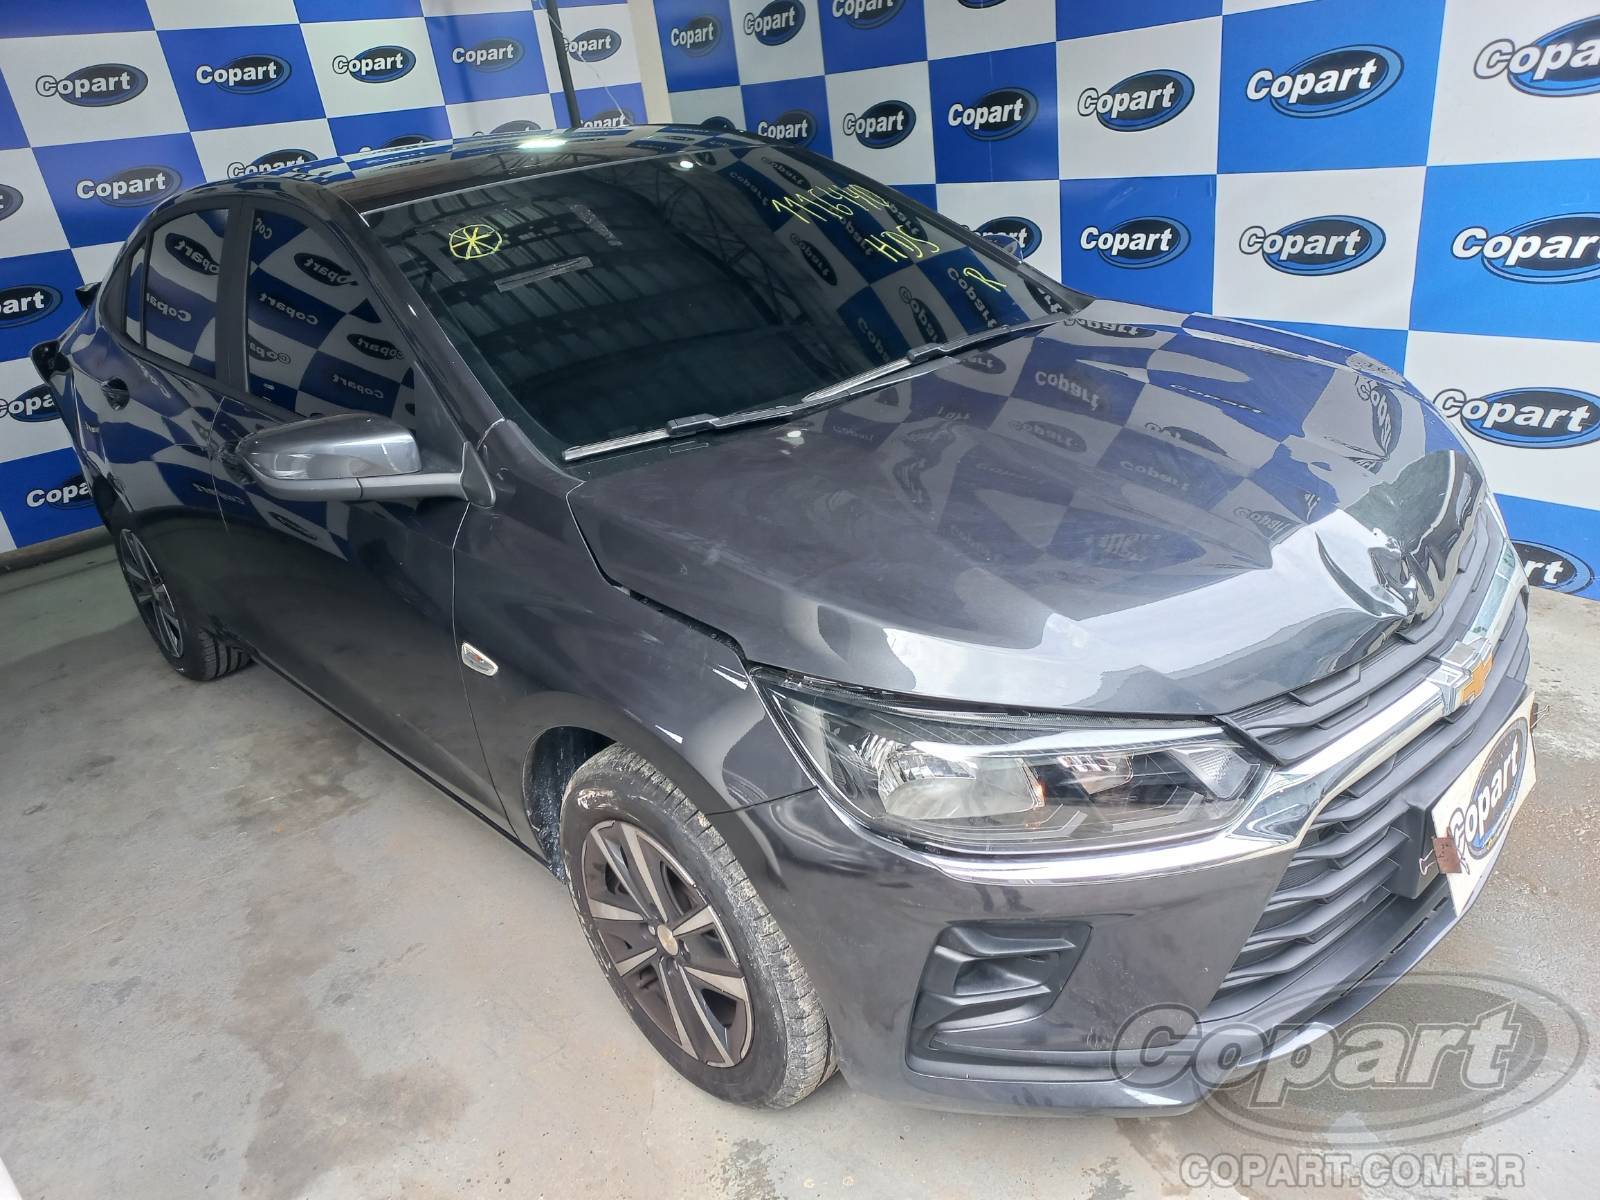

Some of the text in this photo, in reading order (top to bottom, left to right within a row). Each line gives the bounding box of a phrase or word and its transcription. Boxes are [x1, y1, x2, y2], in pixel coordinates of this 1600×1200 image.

[671, 22, 713, 48] Copart
[744, 7, 795, 37] Copart
[332, 51, 403, 75] Copart
[452, 43, 514, 66] Copart
[1474, 38, 1600, 80] Copa
[36, 71, 131, 98] Copart
[195, 59, 277, 86] Copart
[1246, 57, 1378, 104] Copart
[948, 98, 1023, 130] Copart
[1077, 80, 1175, 119] Copart
[758, 118, 808, 141] Copart
[843, 108, 904, 136] Copart
[76, 172, 167, 200] Copart
[1080, 225, 1173, 257] Copart
[1239, 225, 1361, 261] Copart
[1450, 225, 1600, 267] Copar
[1433, 388, 1591, 433] Copart
[26, 482, 91, 508] Copa
[1450, 736, 1519, 858] Copart
